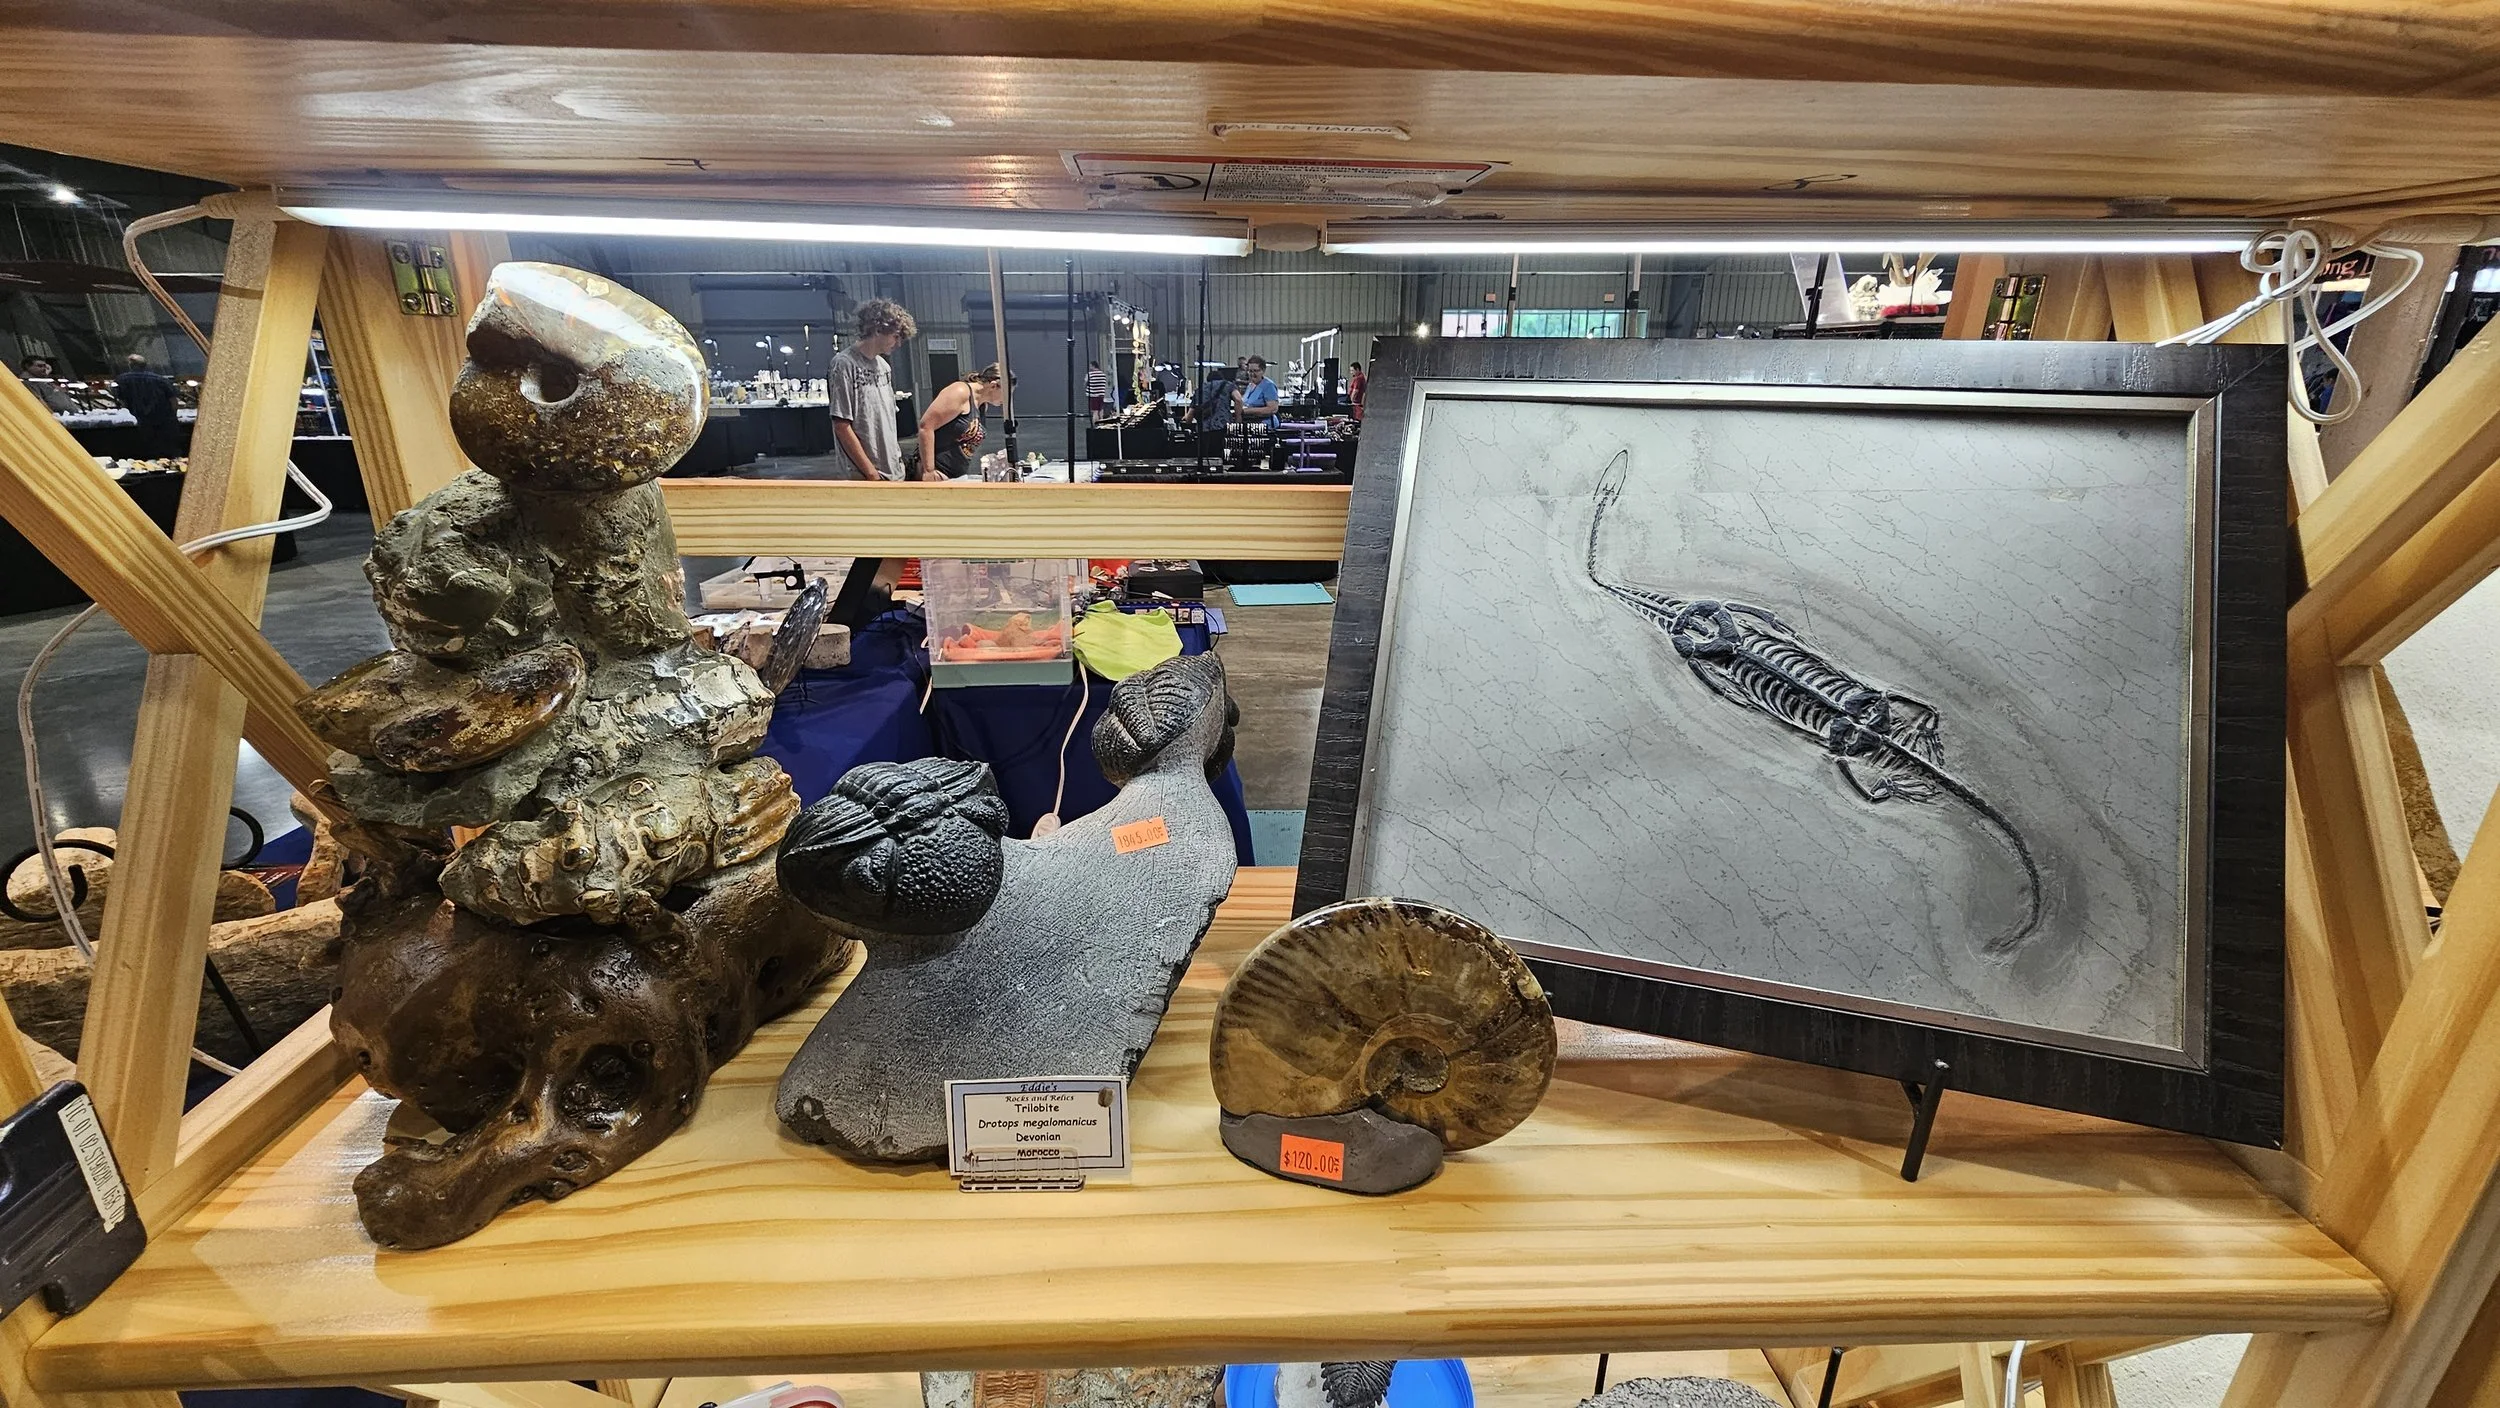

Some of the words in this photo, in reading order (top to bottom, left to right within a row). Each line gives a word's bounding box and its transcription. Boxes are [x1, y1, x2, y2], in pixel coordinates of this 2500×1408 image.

[1020, 1082, 1058, 1092] Eddie's
[1014, 1103, 1060, 1113] Trilobite
[978, 1118, 1019, 1130] Drotops
[1023, 1117, 1097, 1129] megalomanicus
[1016, 1133, 1061, 1142] Devonian
[1017, 1149, 1060, 1157] Morocco
[1284, 1150, 1334, 1173] $120.00
